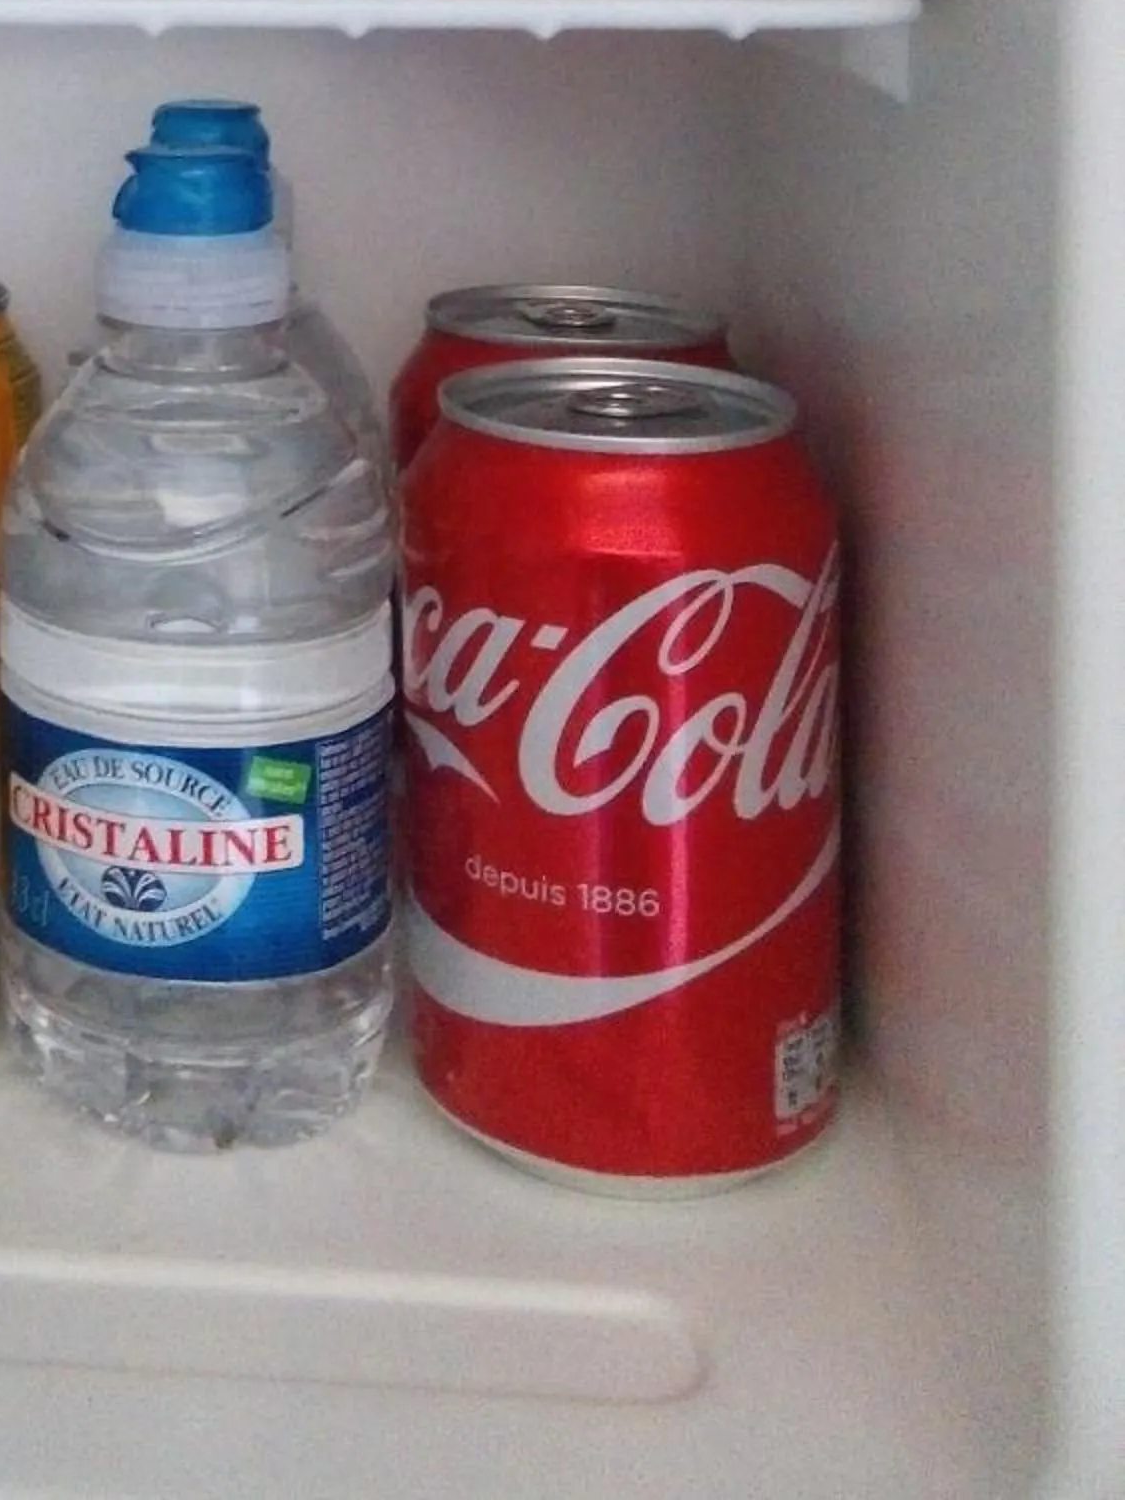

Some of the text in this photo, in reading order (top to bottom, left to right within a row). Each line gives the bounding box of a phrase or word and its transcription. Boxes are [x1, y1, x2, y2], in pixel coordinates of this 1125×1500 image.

[53, 757, 87, 790] EAU
[94, 756, 124, 779] DE
[131, 760, 232, 812] SOURCE
[11, 785, 293, 867] CRISTALINE
[465, 854, 660, 918] depuis 1886
[114, 904, 223, 941] NATUREL
